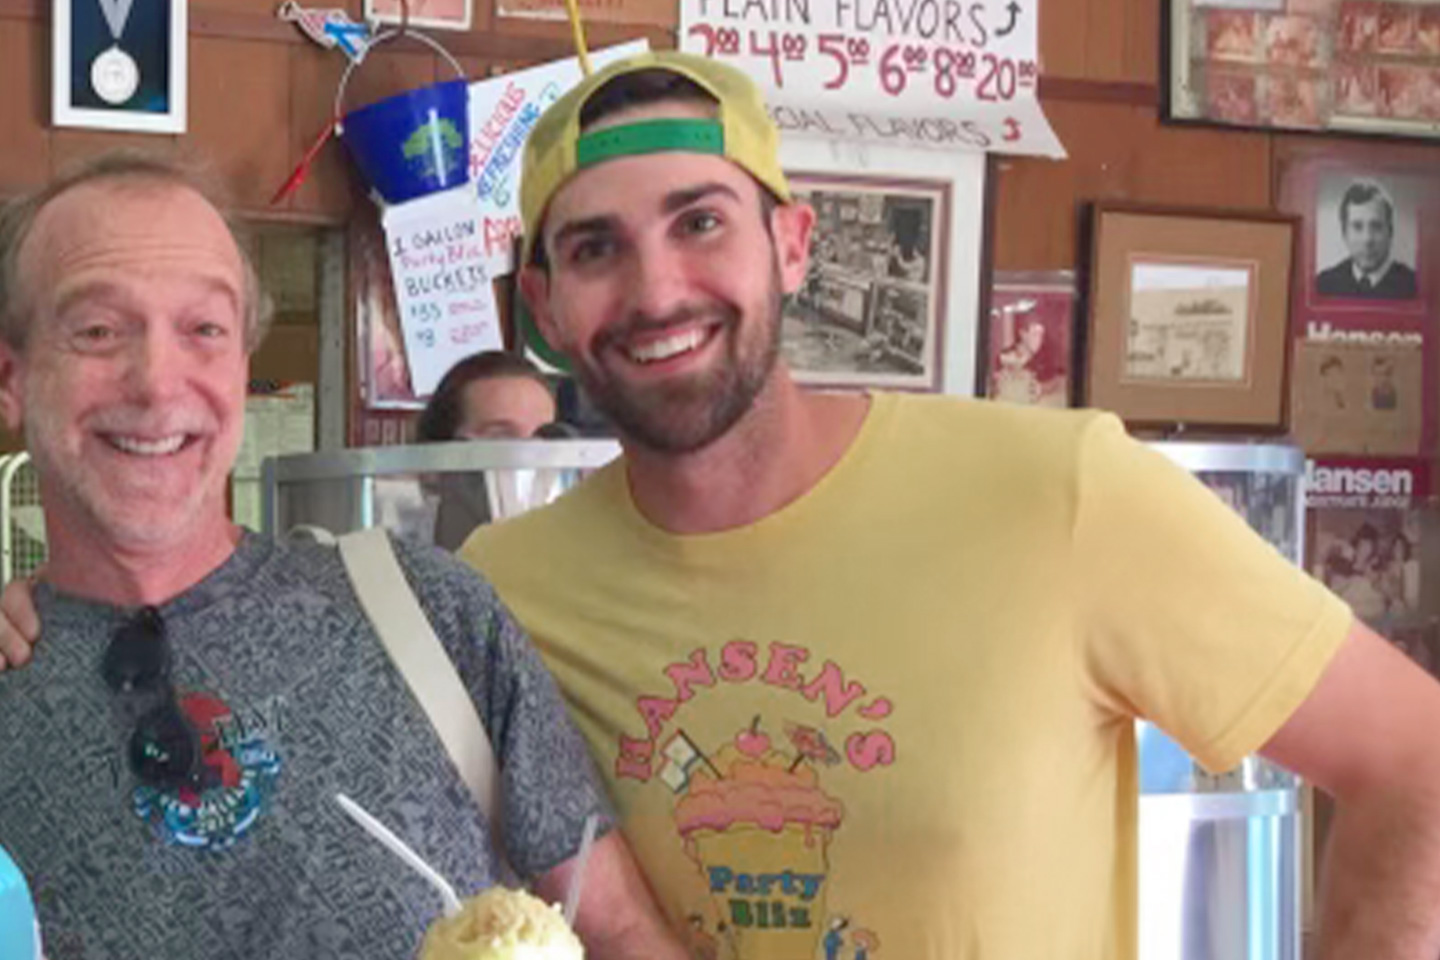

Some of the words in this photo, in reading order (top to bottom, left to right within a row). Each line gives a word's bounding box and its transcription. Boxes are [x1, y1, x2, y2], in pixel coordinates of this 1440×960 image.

[835, 0, 988, 48] FLAVORS
[615, 640, 895, 783] HANSEN'S
[707, 865, 825, 899] Party
[729, 898, 812, 929] Bliz
